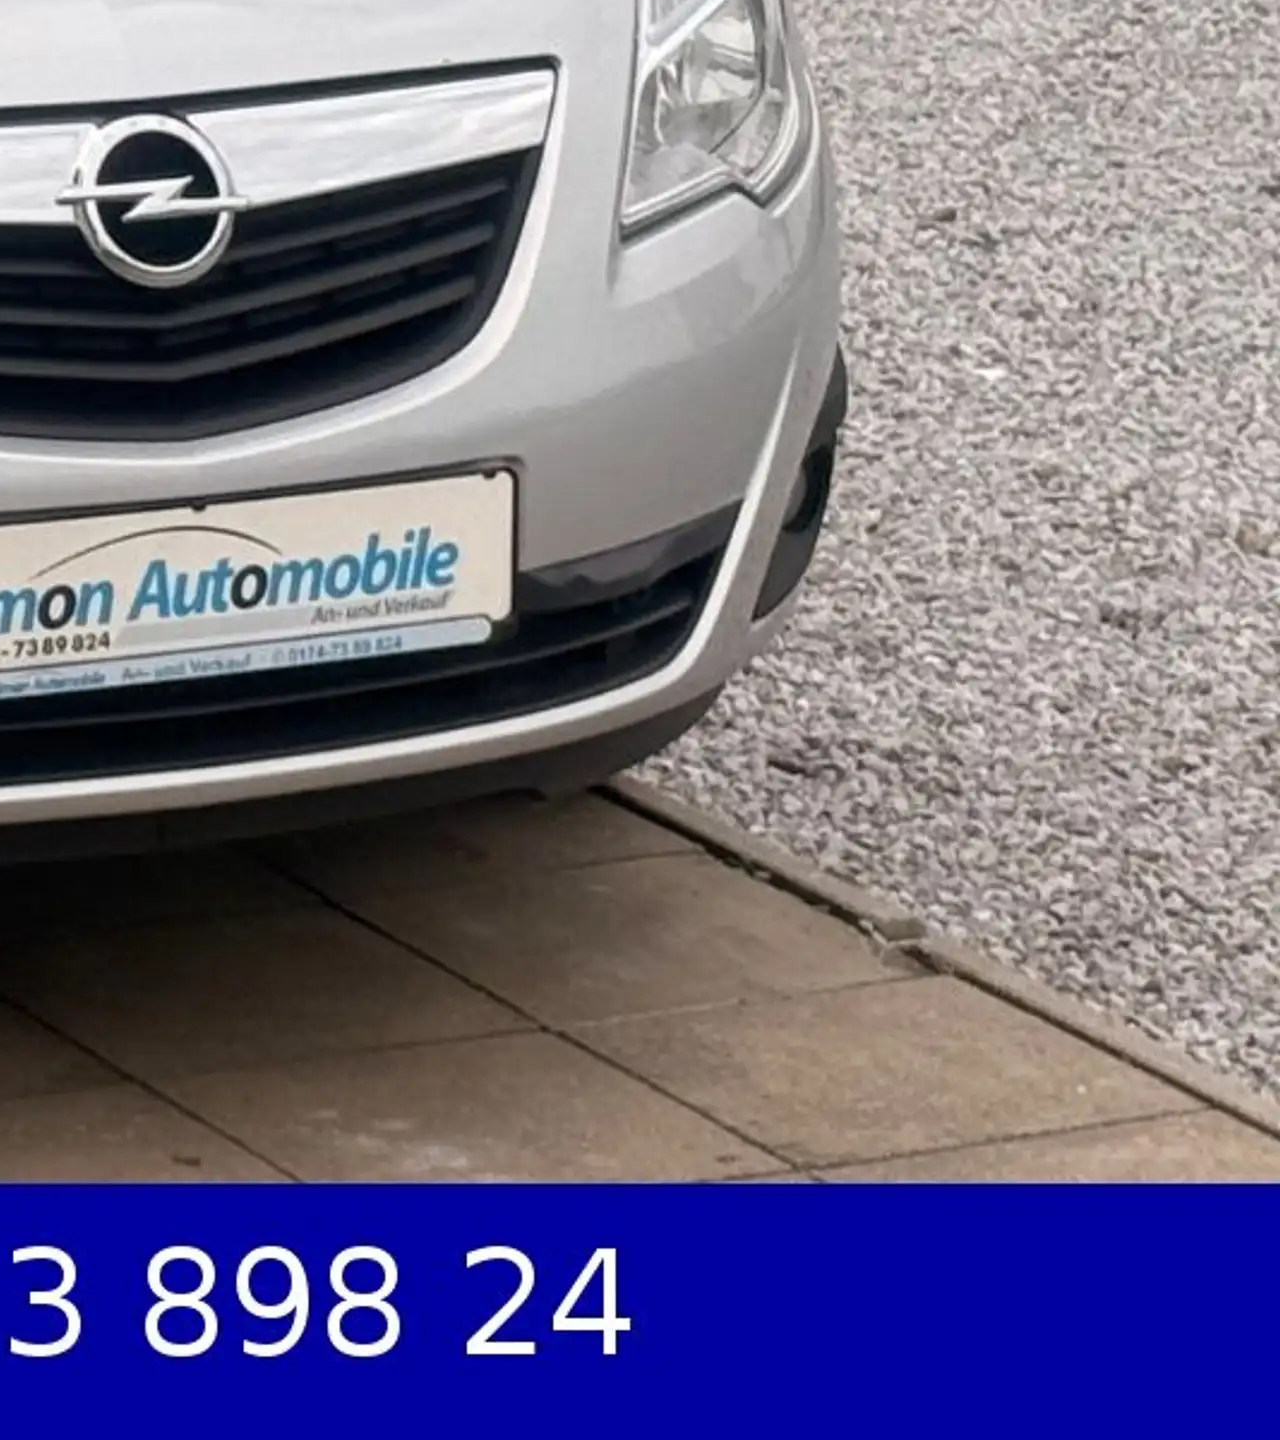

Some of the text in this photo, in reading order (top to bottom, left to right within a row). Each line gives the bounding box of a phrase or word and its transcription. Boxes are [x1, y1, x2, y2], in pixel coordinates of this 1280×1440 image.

[126, 526, 459, 622] Automobile
[346, 599, 381, 620] und
[383, 590, 453, 616] Verkauf
